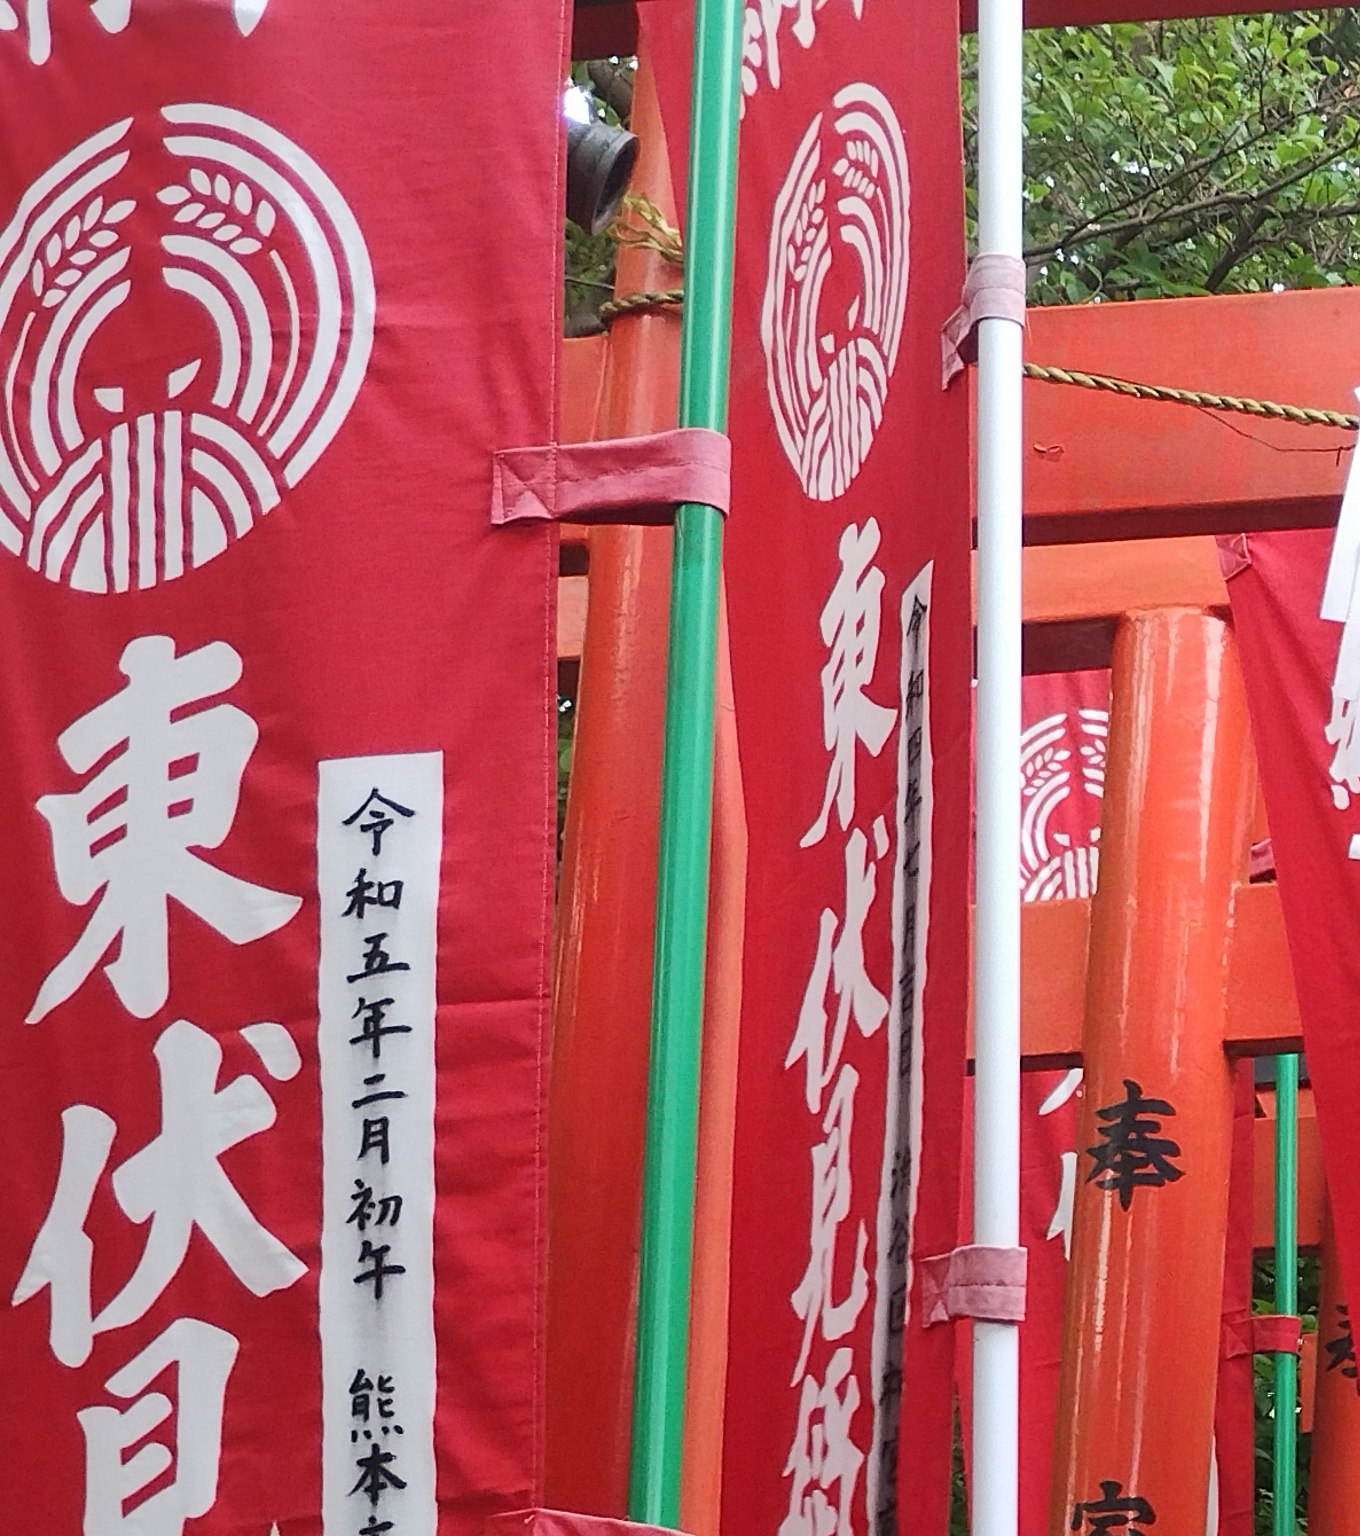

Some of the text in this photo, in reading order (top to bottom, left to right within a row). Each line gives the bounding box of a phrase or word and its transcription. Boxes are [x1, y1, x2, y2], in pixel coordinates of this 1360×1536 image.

[343, 786, 415, 1304] 令和五年二月初午
[1087, 1080, 1186, 1212] 奉
